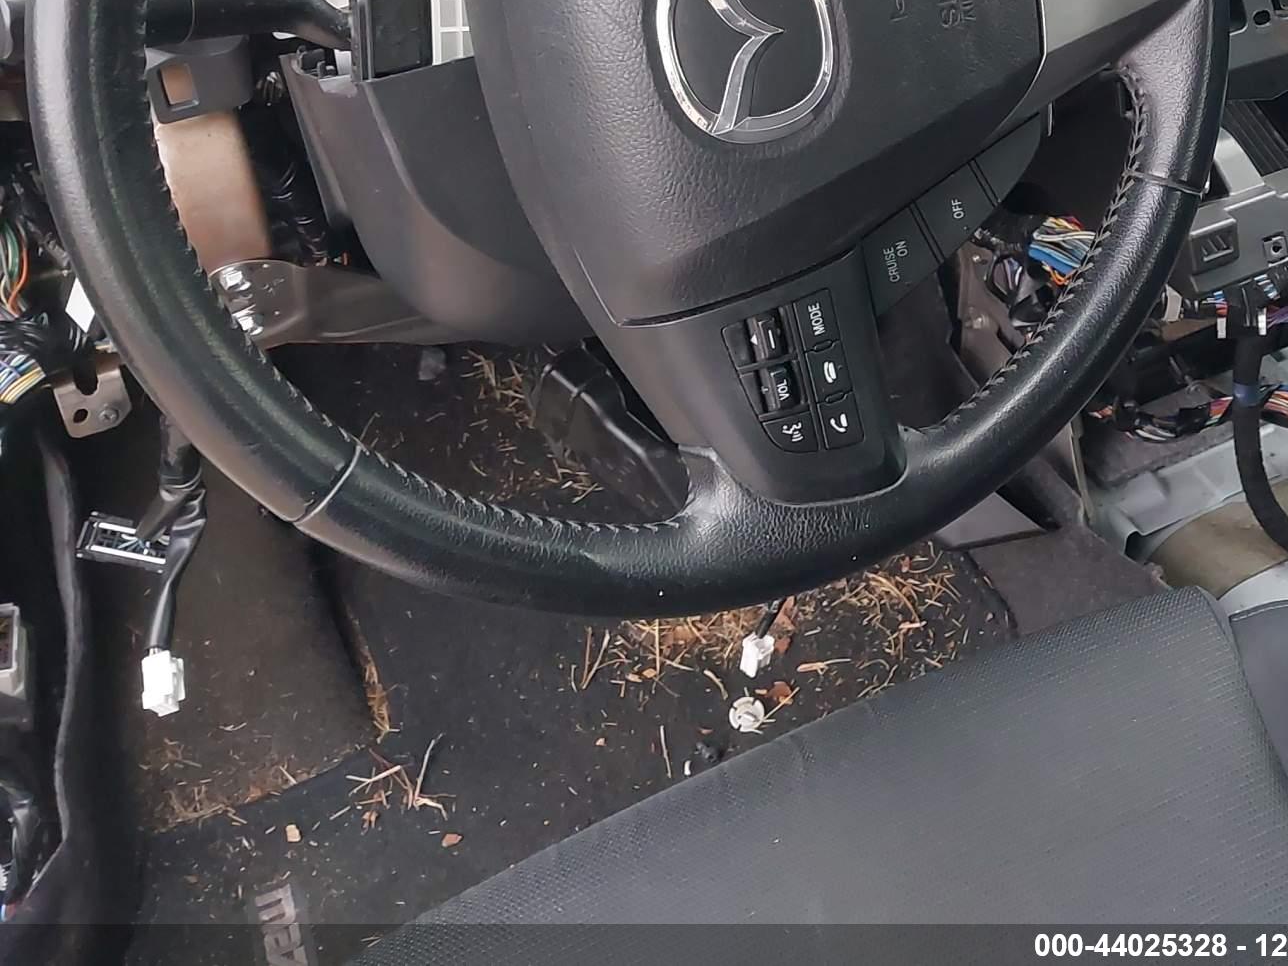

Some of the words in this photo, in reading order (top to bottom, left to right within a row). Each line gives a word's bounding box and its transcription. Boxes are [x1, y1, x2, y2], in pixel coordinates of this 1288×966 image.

[951, 198, 964, 219] OFF
[896, 240, 909, 257] ON
[883, 247, 900, 283] CRUISE
[808, 302, 826, 336] MODE
[776, 379, 790, 401] VOL
